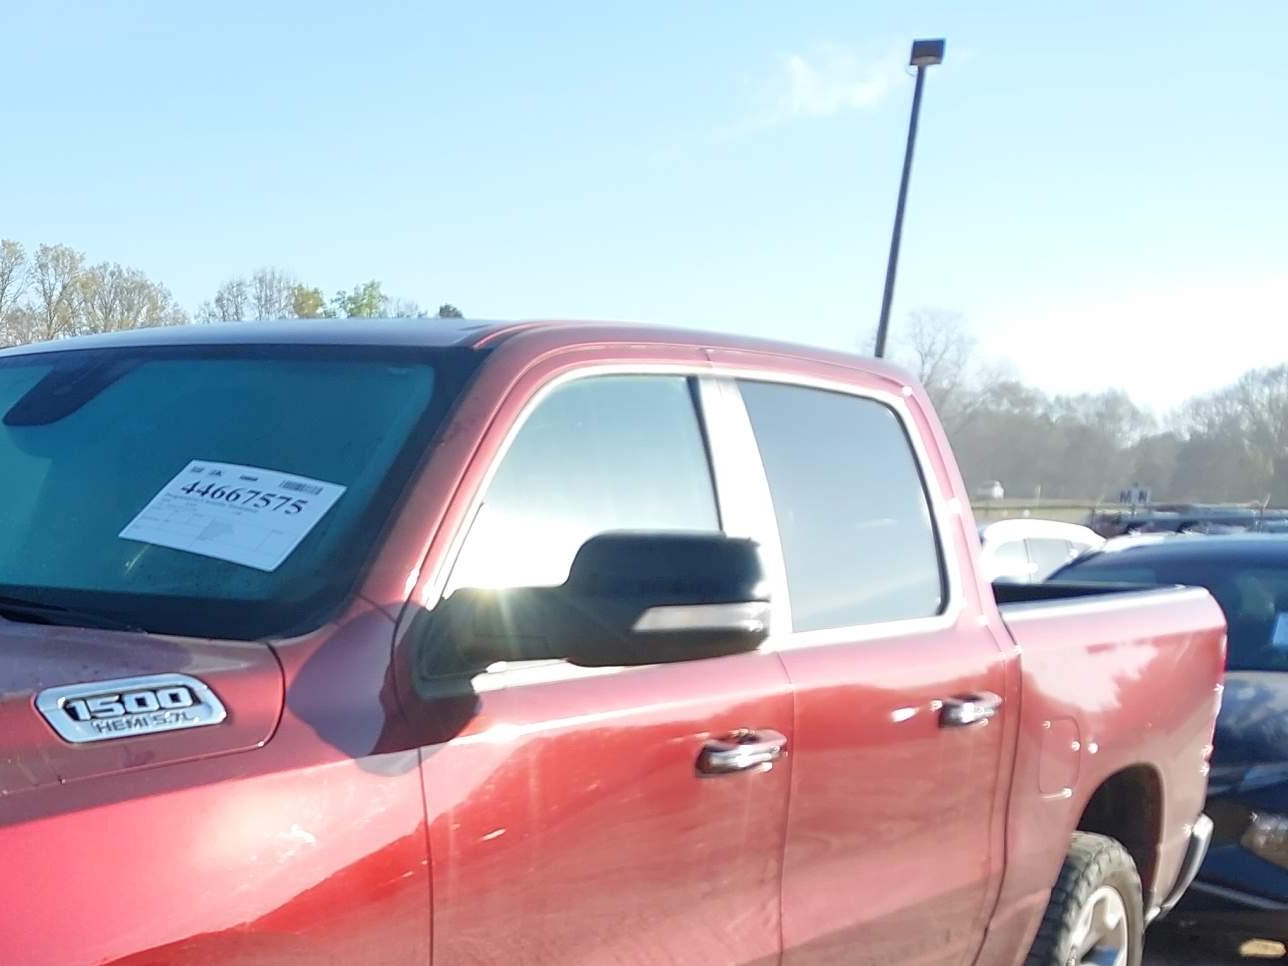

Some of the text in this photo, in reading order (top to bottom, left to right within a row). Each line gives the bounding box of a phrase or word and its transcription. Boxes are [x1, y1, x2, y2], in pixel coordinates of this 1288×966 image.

[180, 480, 309, 516] 44667575
[65, 686, 195, 721] 1500
[94, 710, 196, 734] HEMI 5.7L
